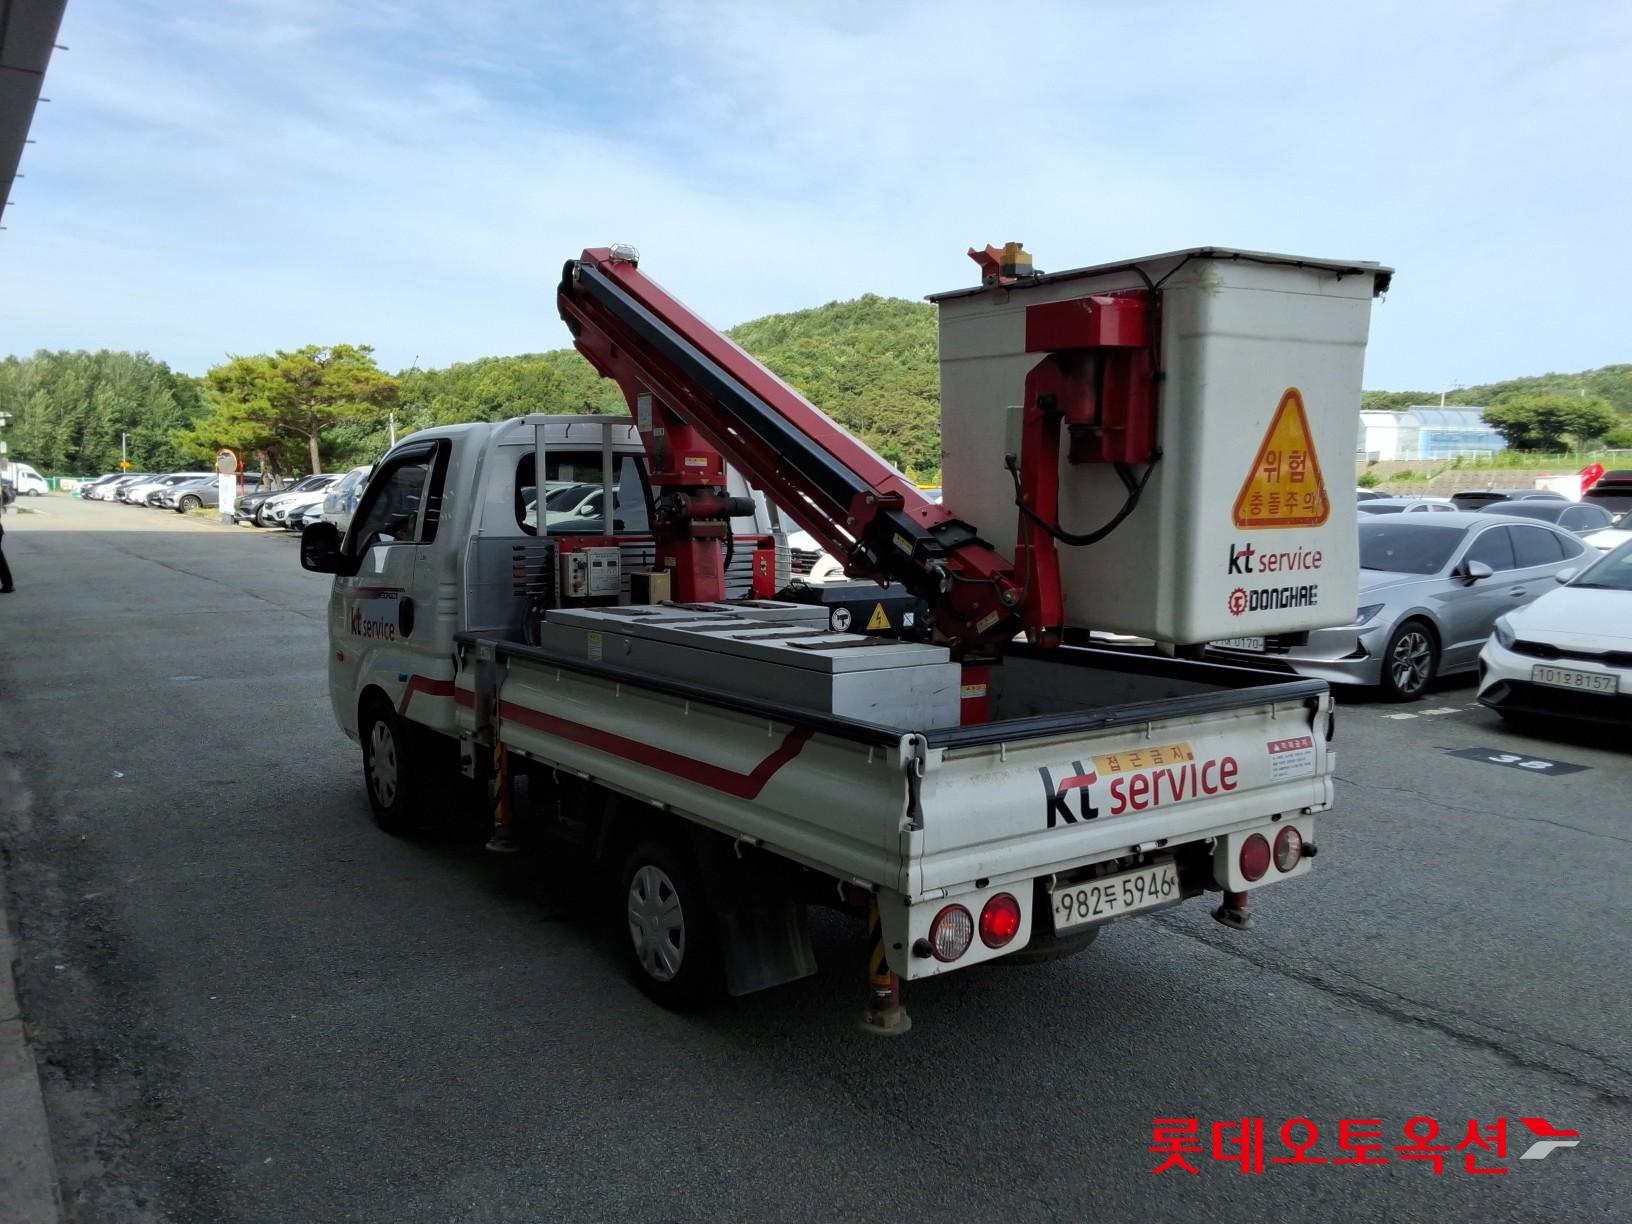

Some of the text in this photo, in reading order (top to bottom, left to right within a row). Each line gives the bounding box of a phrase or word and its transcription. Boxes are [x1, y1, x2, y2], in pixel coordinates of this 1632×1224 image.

[1264, 450, 1307, 483] 위험
[1249, 491, 1315, 515] 충돌주의
[1228, 543, 1322, 575] kt service
[1248, 584, 1318, 612] DONGHAE
[351, 607, 395, 641] kt service
[1106, 747, 1184, 772] 접근금지
[1038, 752, 1238, 829] kt service
